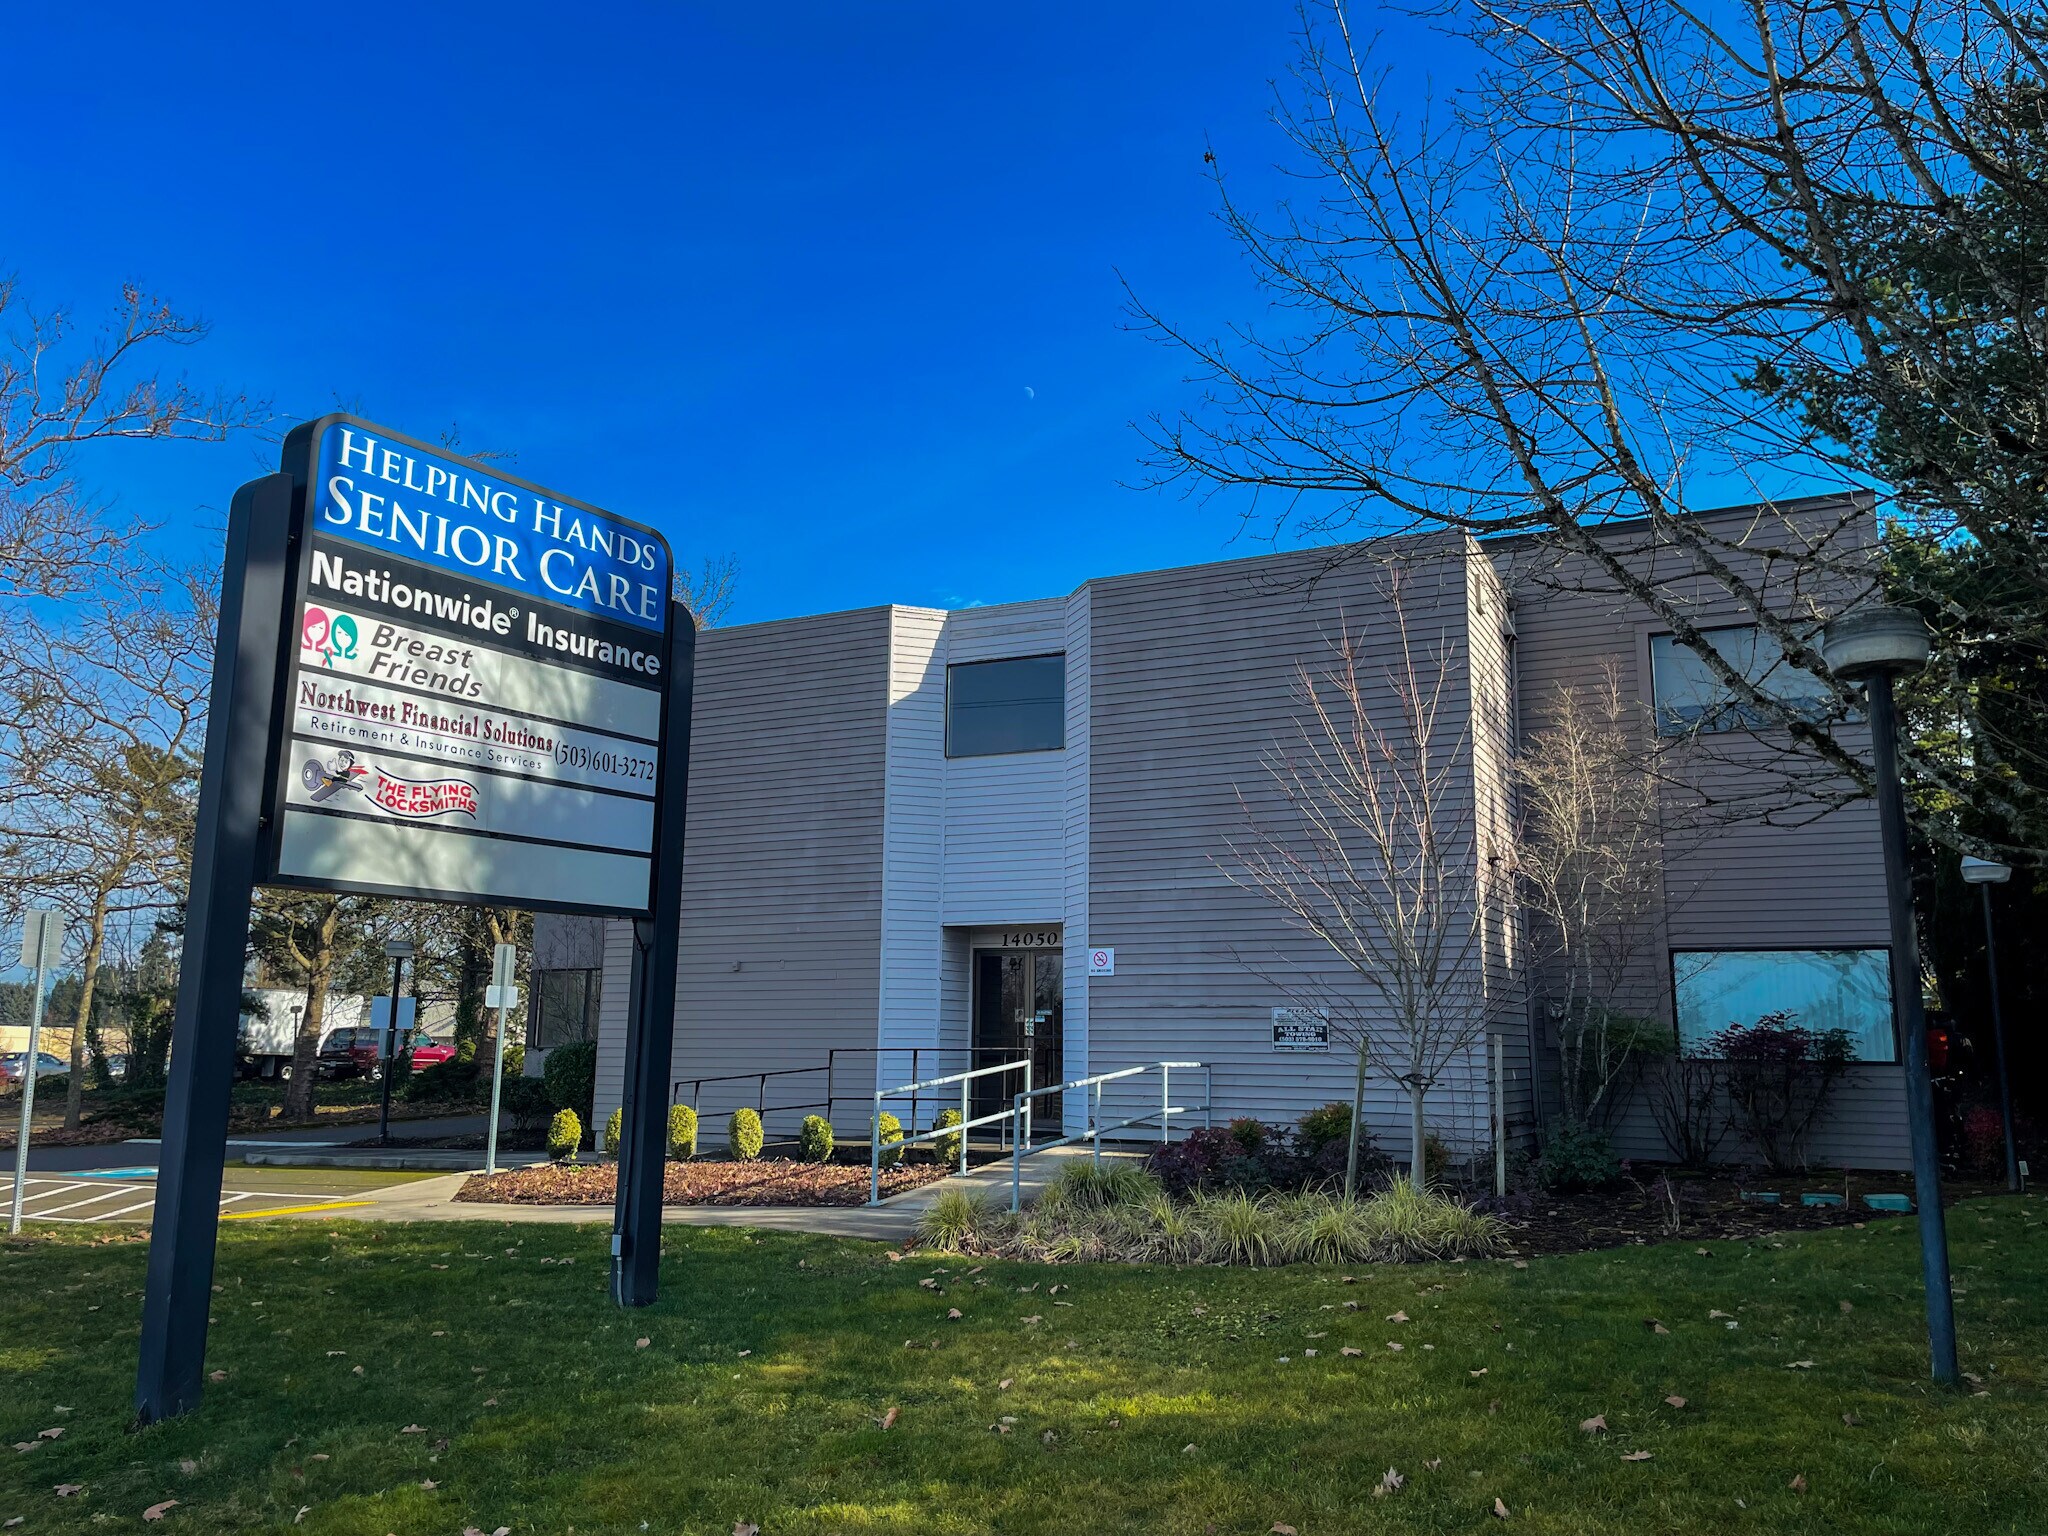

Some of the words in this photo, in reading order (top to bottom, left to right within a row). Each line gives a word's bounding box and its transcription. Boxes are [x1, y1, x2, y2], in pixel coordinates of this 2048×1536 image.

[338, 428, 518, 523] HELPING
[532, 498, 656, 571] HANDS
[325, 476, 526, 581] SENIOR
[540, 549, 658, 621] CARE
[370, 624, 473, 669] Breast
[527, 611, 661, 675] Insurance
[368, 651, 482, 697] Friends
[300, 681, 396, 721] Northwest
[401, 701, 478, 737] Financial
[483, 719, 553, 752] Solutions
[311, 716, 394, 743] Retirement
[400, 733, 409, 745] &
[416, 735, 482, 759] Insurance
[487, 749, 542, 770] Services
[555, 740, 655, 780] (503)601-3272
[375, 790, 478, 813] LOCKSMITHS
[378, 775, 406, 797] THE
[412, 784, 472, 799] FLYING
[1002, 932, 1058, 947] 14050
